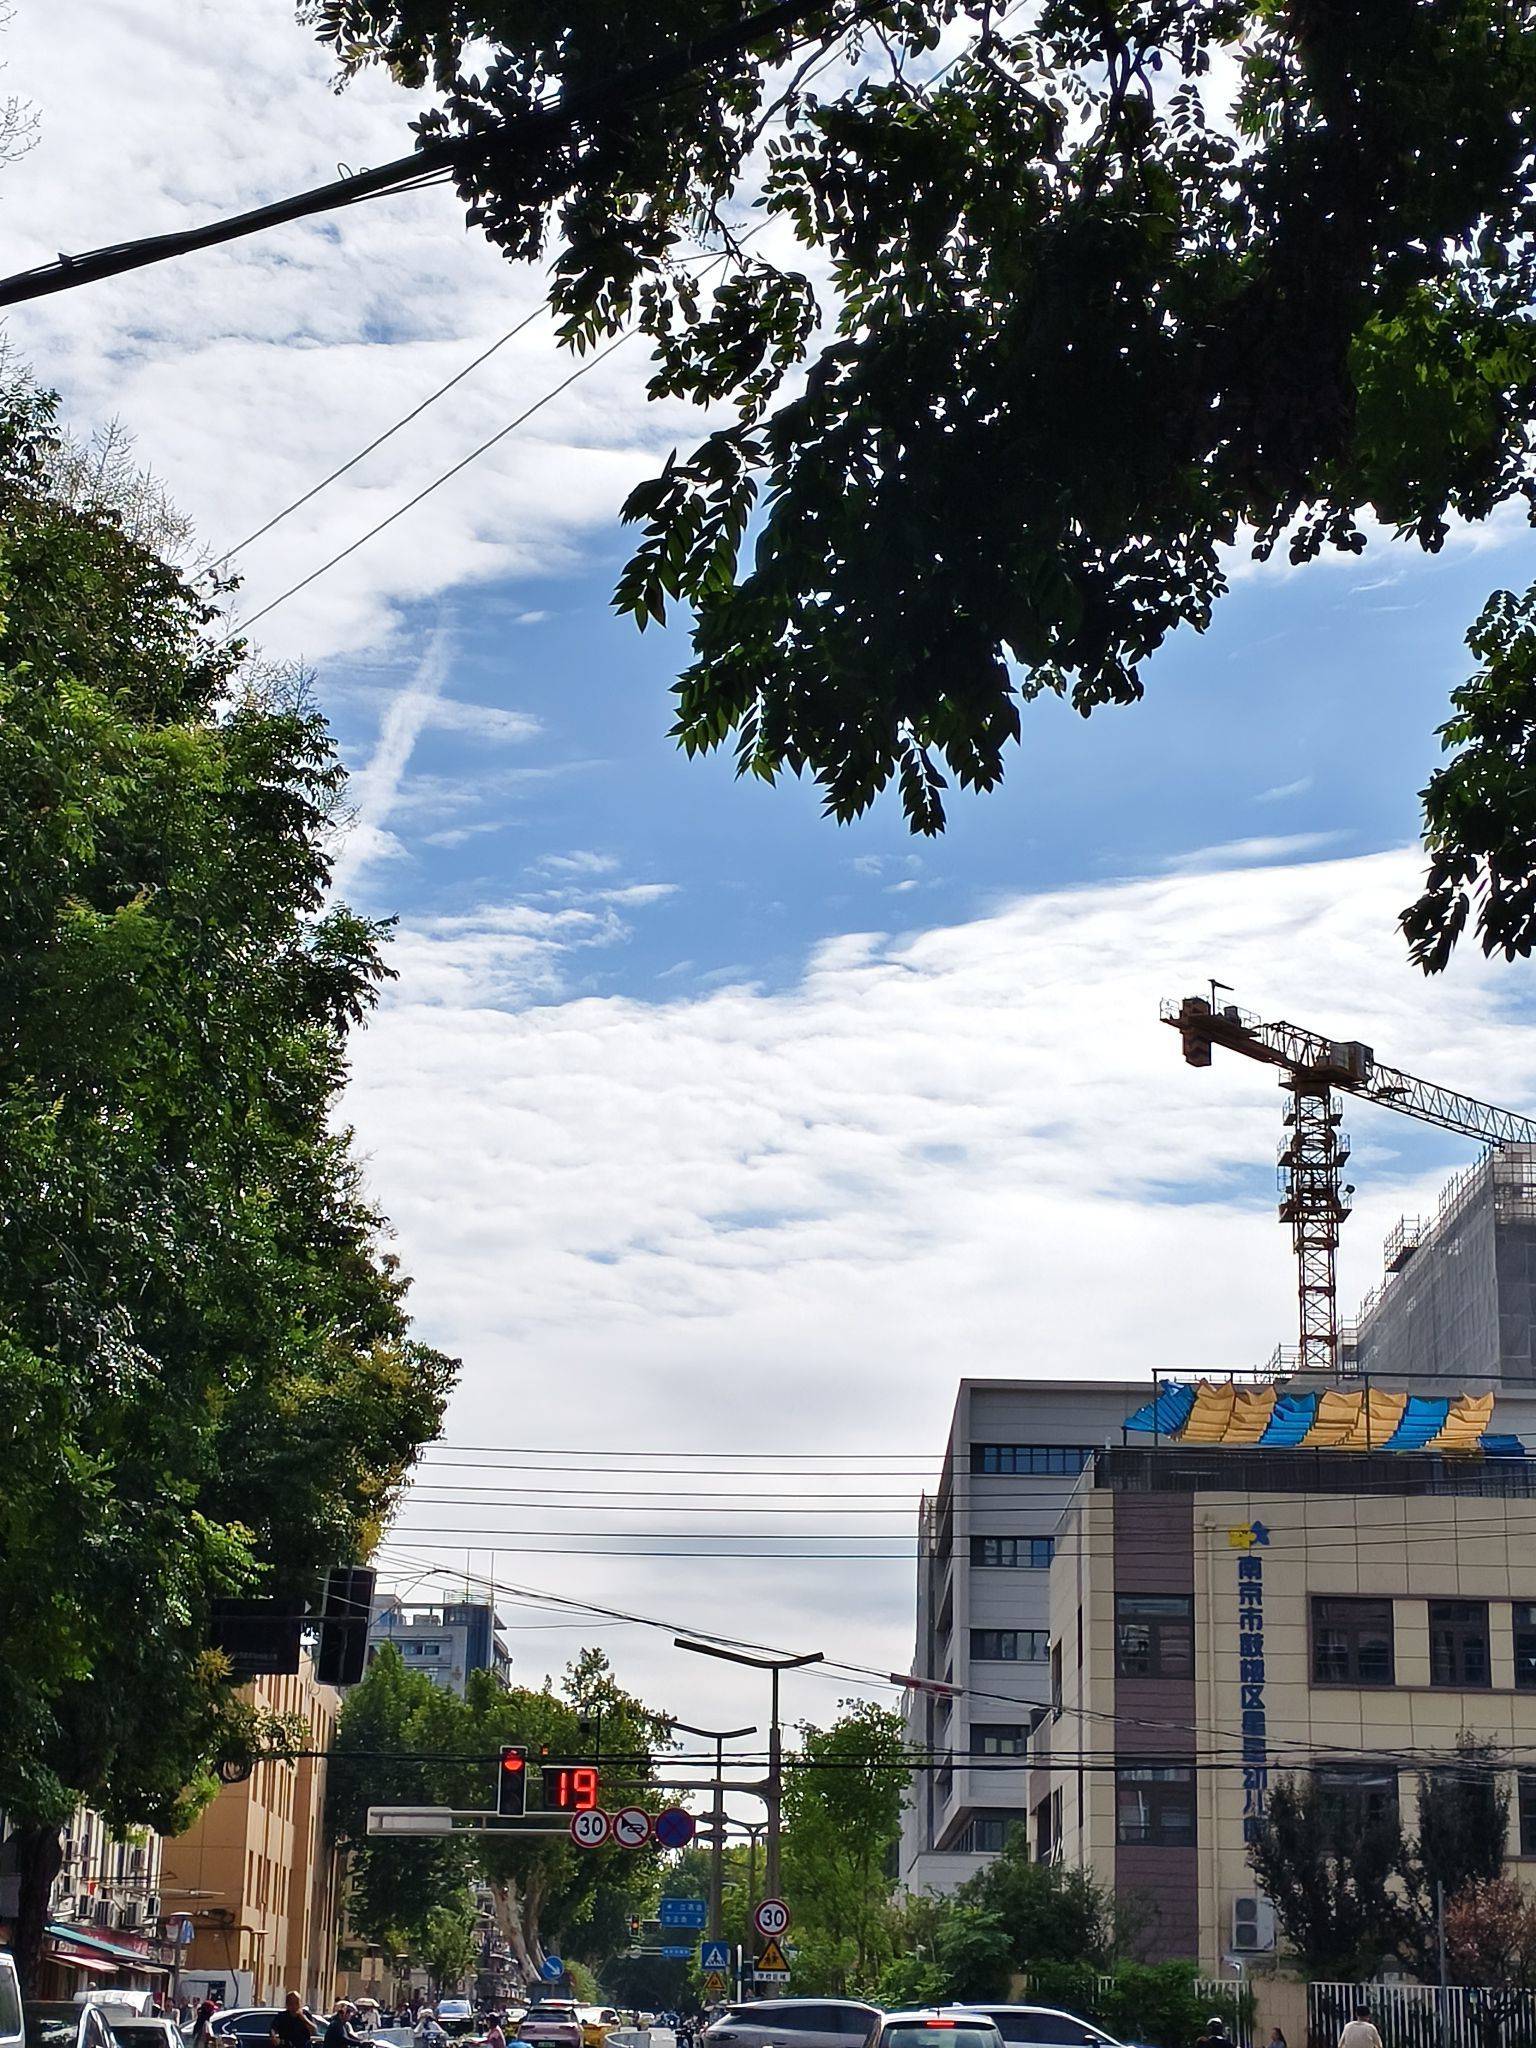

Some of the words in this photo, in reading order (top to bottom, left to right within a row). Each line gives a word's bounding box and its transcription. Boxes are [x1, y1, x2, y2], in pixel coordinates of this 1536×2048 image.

[560, 1770, 596, 1809] 19
[579, 1816, 604, 1836] 30
[762, 1909, 785, 1927] 30
